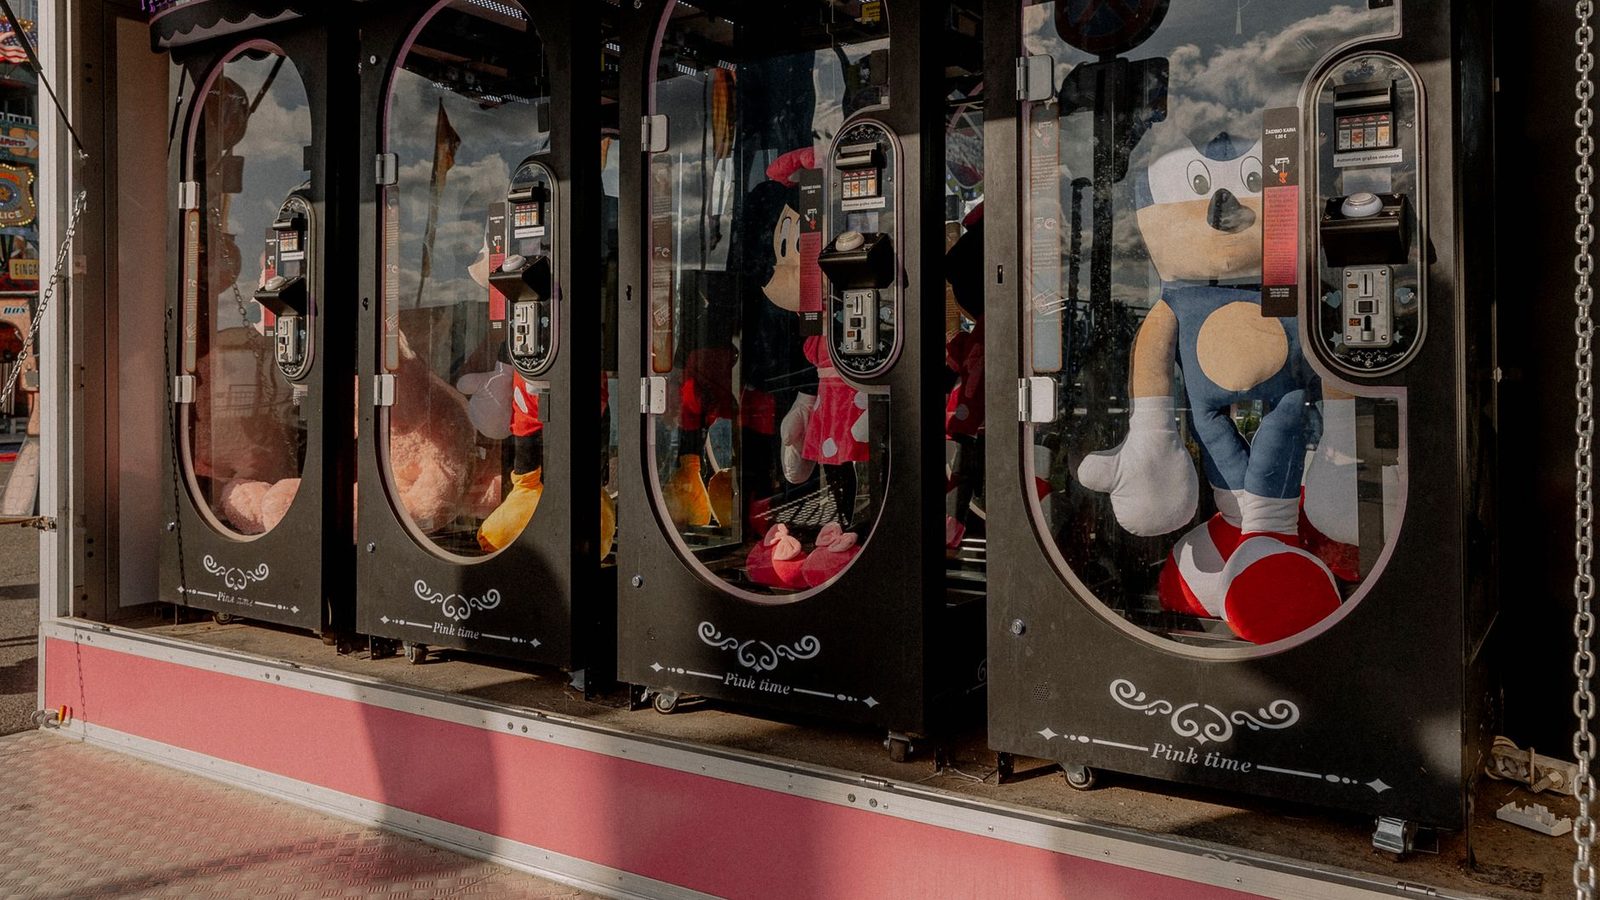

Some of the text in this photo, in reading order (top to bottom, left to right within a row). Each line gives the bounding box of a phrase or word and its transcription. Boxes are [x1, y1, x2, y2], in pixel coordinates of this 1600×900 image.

[433, 621, 480, 640] Pink time
[723, 672, 791, 695] Pink time
[1150, 742, 1252, 774] Pink time
